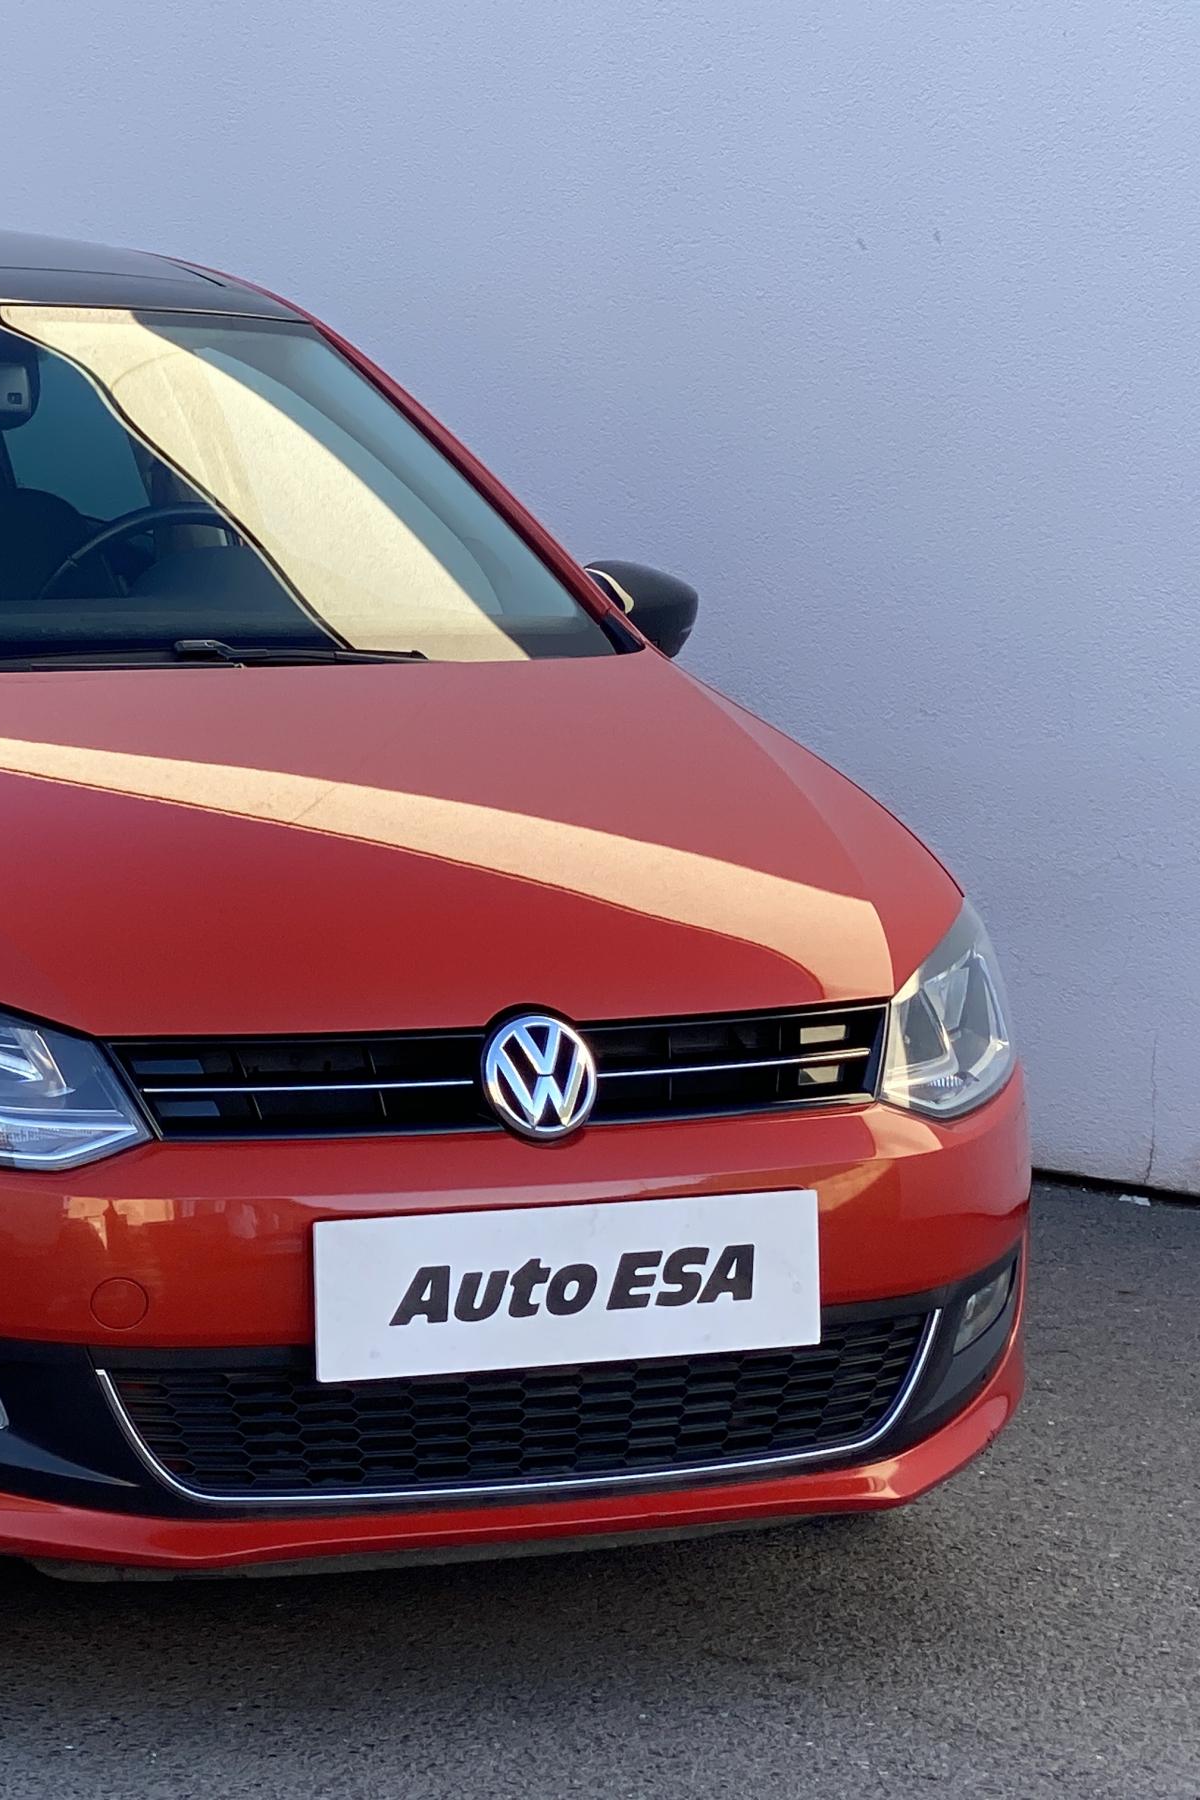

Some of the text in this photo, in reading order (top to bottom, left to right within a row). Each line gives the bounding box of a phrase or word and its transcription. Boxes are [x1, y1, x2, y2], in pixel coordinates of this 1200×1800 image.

[490, 1020, 589, 1130] VW
[389, 1244, 755, 1326] Auto ESA
